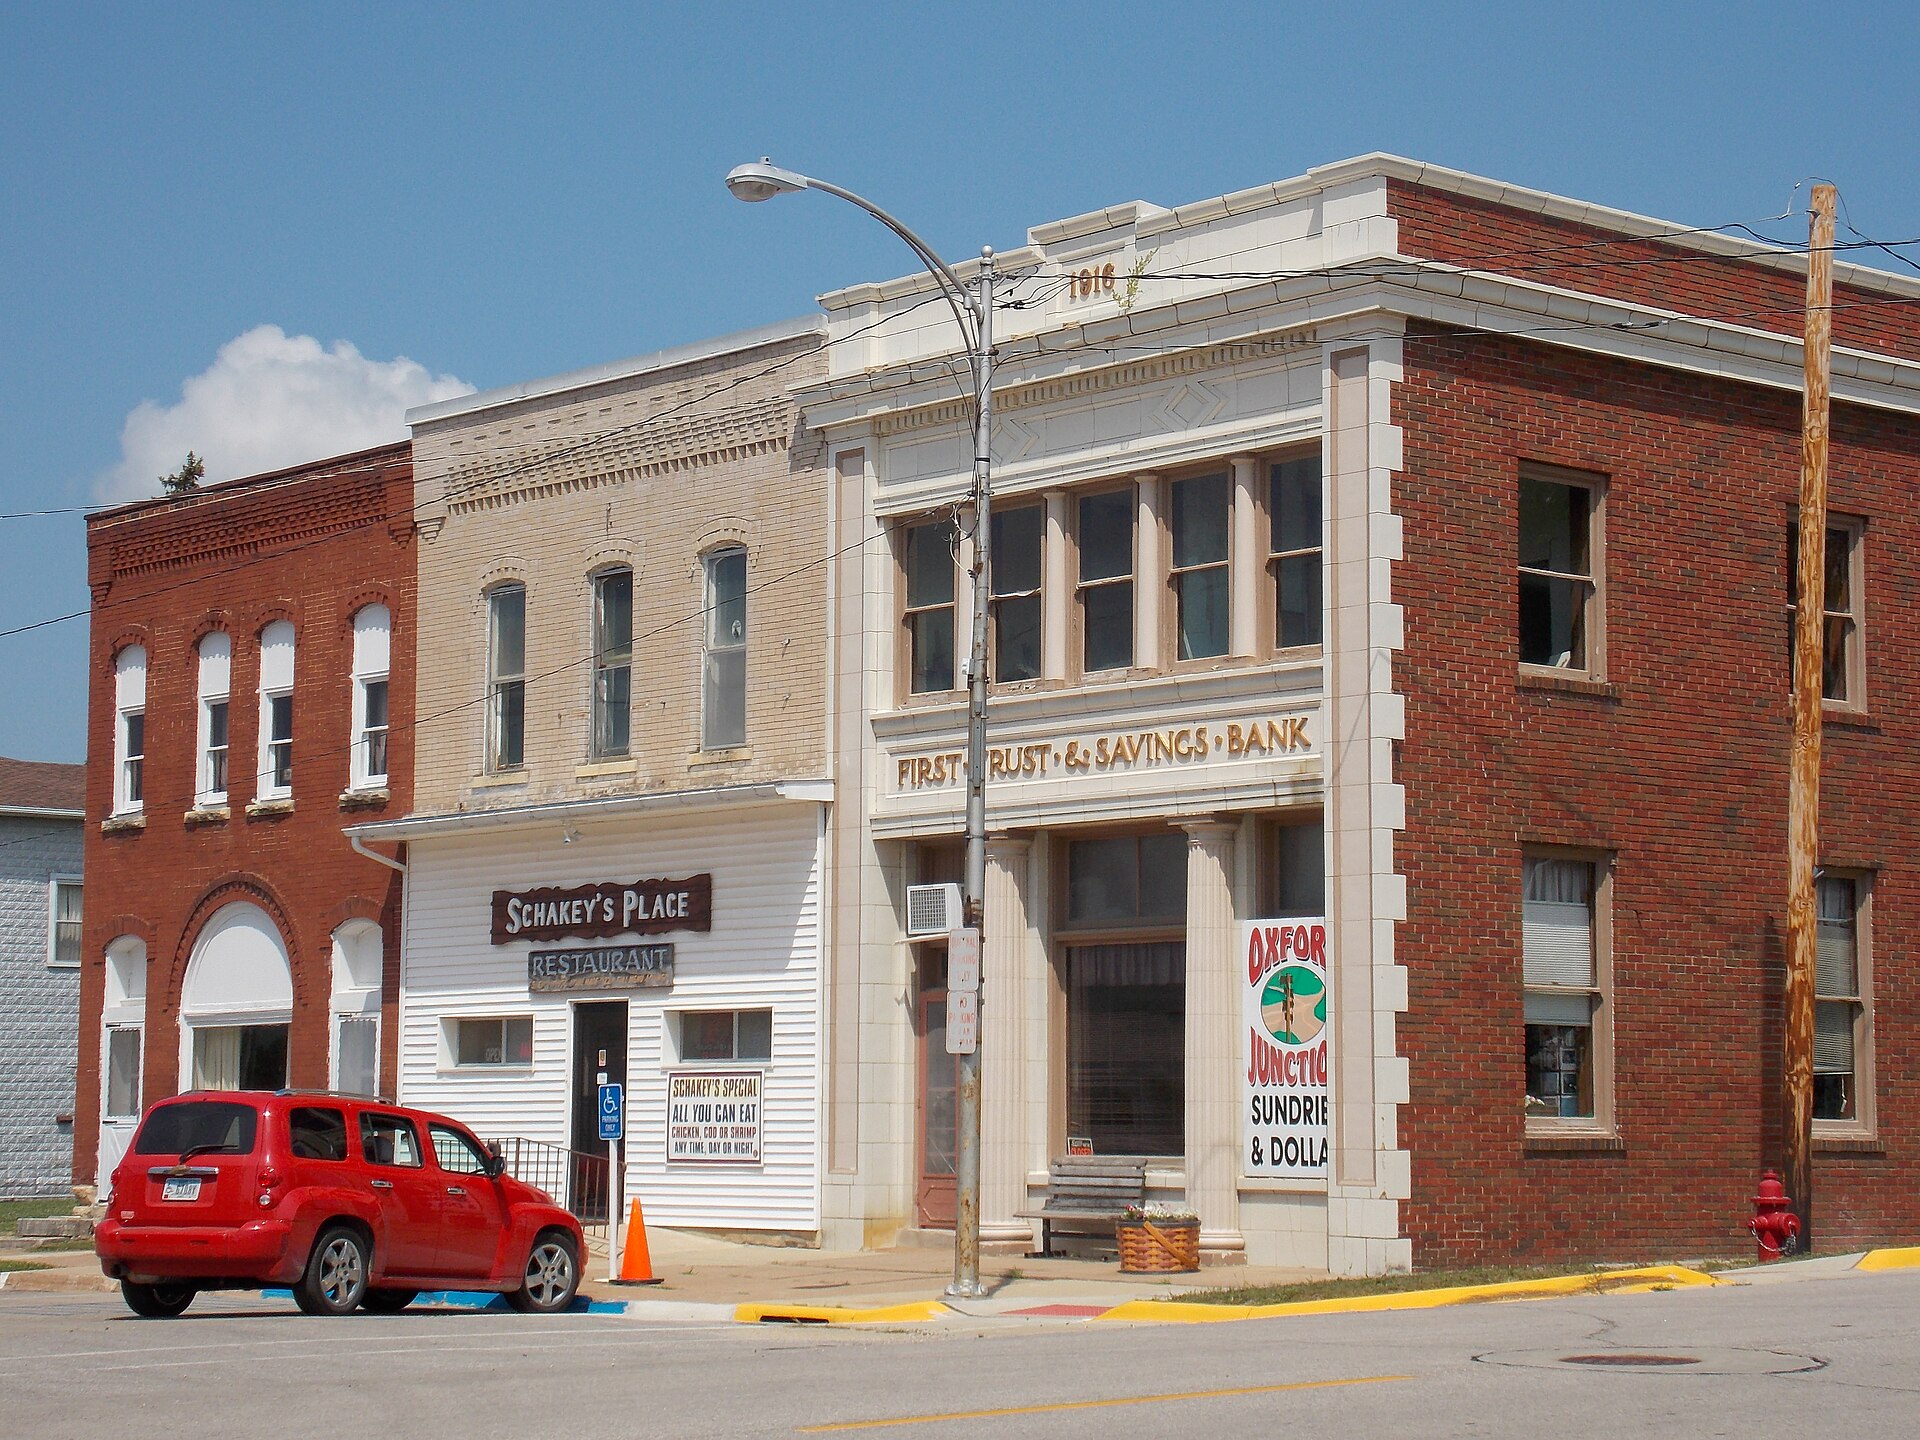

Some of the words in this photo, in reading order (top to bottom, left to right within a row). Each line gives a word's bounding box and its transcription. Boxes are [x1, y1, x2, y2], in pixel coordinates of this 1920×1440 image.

[1069, 262, 1116, 297] 1916
[897, 752, 962, 787] FIRST
[986, 743, 1053, 777] RUST
[1095, 726, 1209, 766] SAVINGS
[1227, 717, 1312, 754] BANK
[623, 890, 690, 928] PLACE
[532, 948, 668, 976] RESTAURANT
[1248, 925, 1326, 986] OXFOR
[673, 1079, 720, 1098] SCHAKEY'S
[722, 1078, 758, 1097] SPECIAL
[672, 1104, 689, 1122] ALL
[693, 1104, 712, 1122] YOU
[715, 1104, 736, 1122] CAN
[739, 1104, 757, 1122] EAT
[671, 1126, 702, 1140] CHICKEN,
[703, 1126, 718, 1139] COD
[719, 1126, 729, 1139] OR
[730, 1126, 757, 1139] SHRIMP
[674, 1141, 688, 1154] ANY
[689, 1141, 707, 1155] TIME,
[708, 1141, 721, 1154] DAY
[722, 1141, 732, 1154] OR
[733, 1141, 754, 1154] NIGHT
[1251, 1135, 1264, 1167] &
